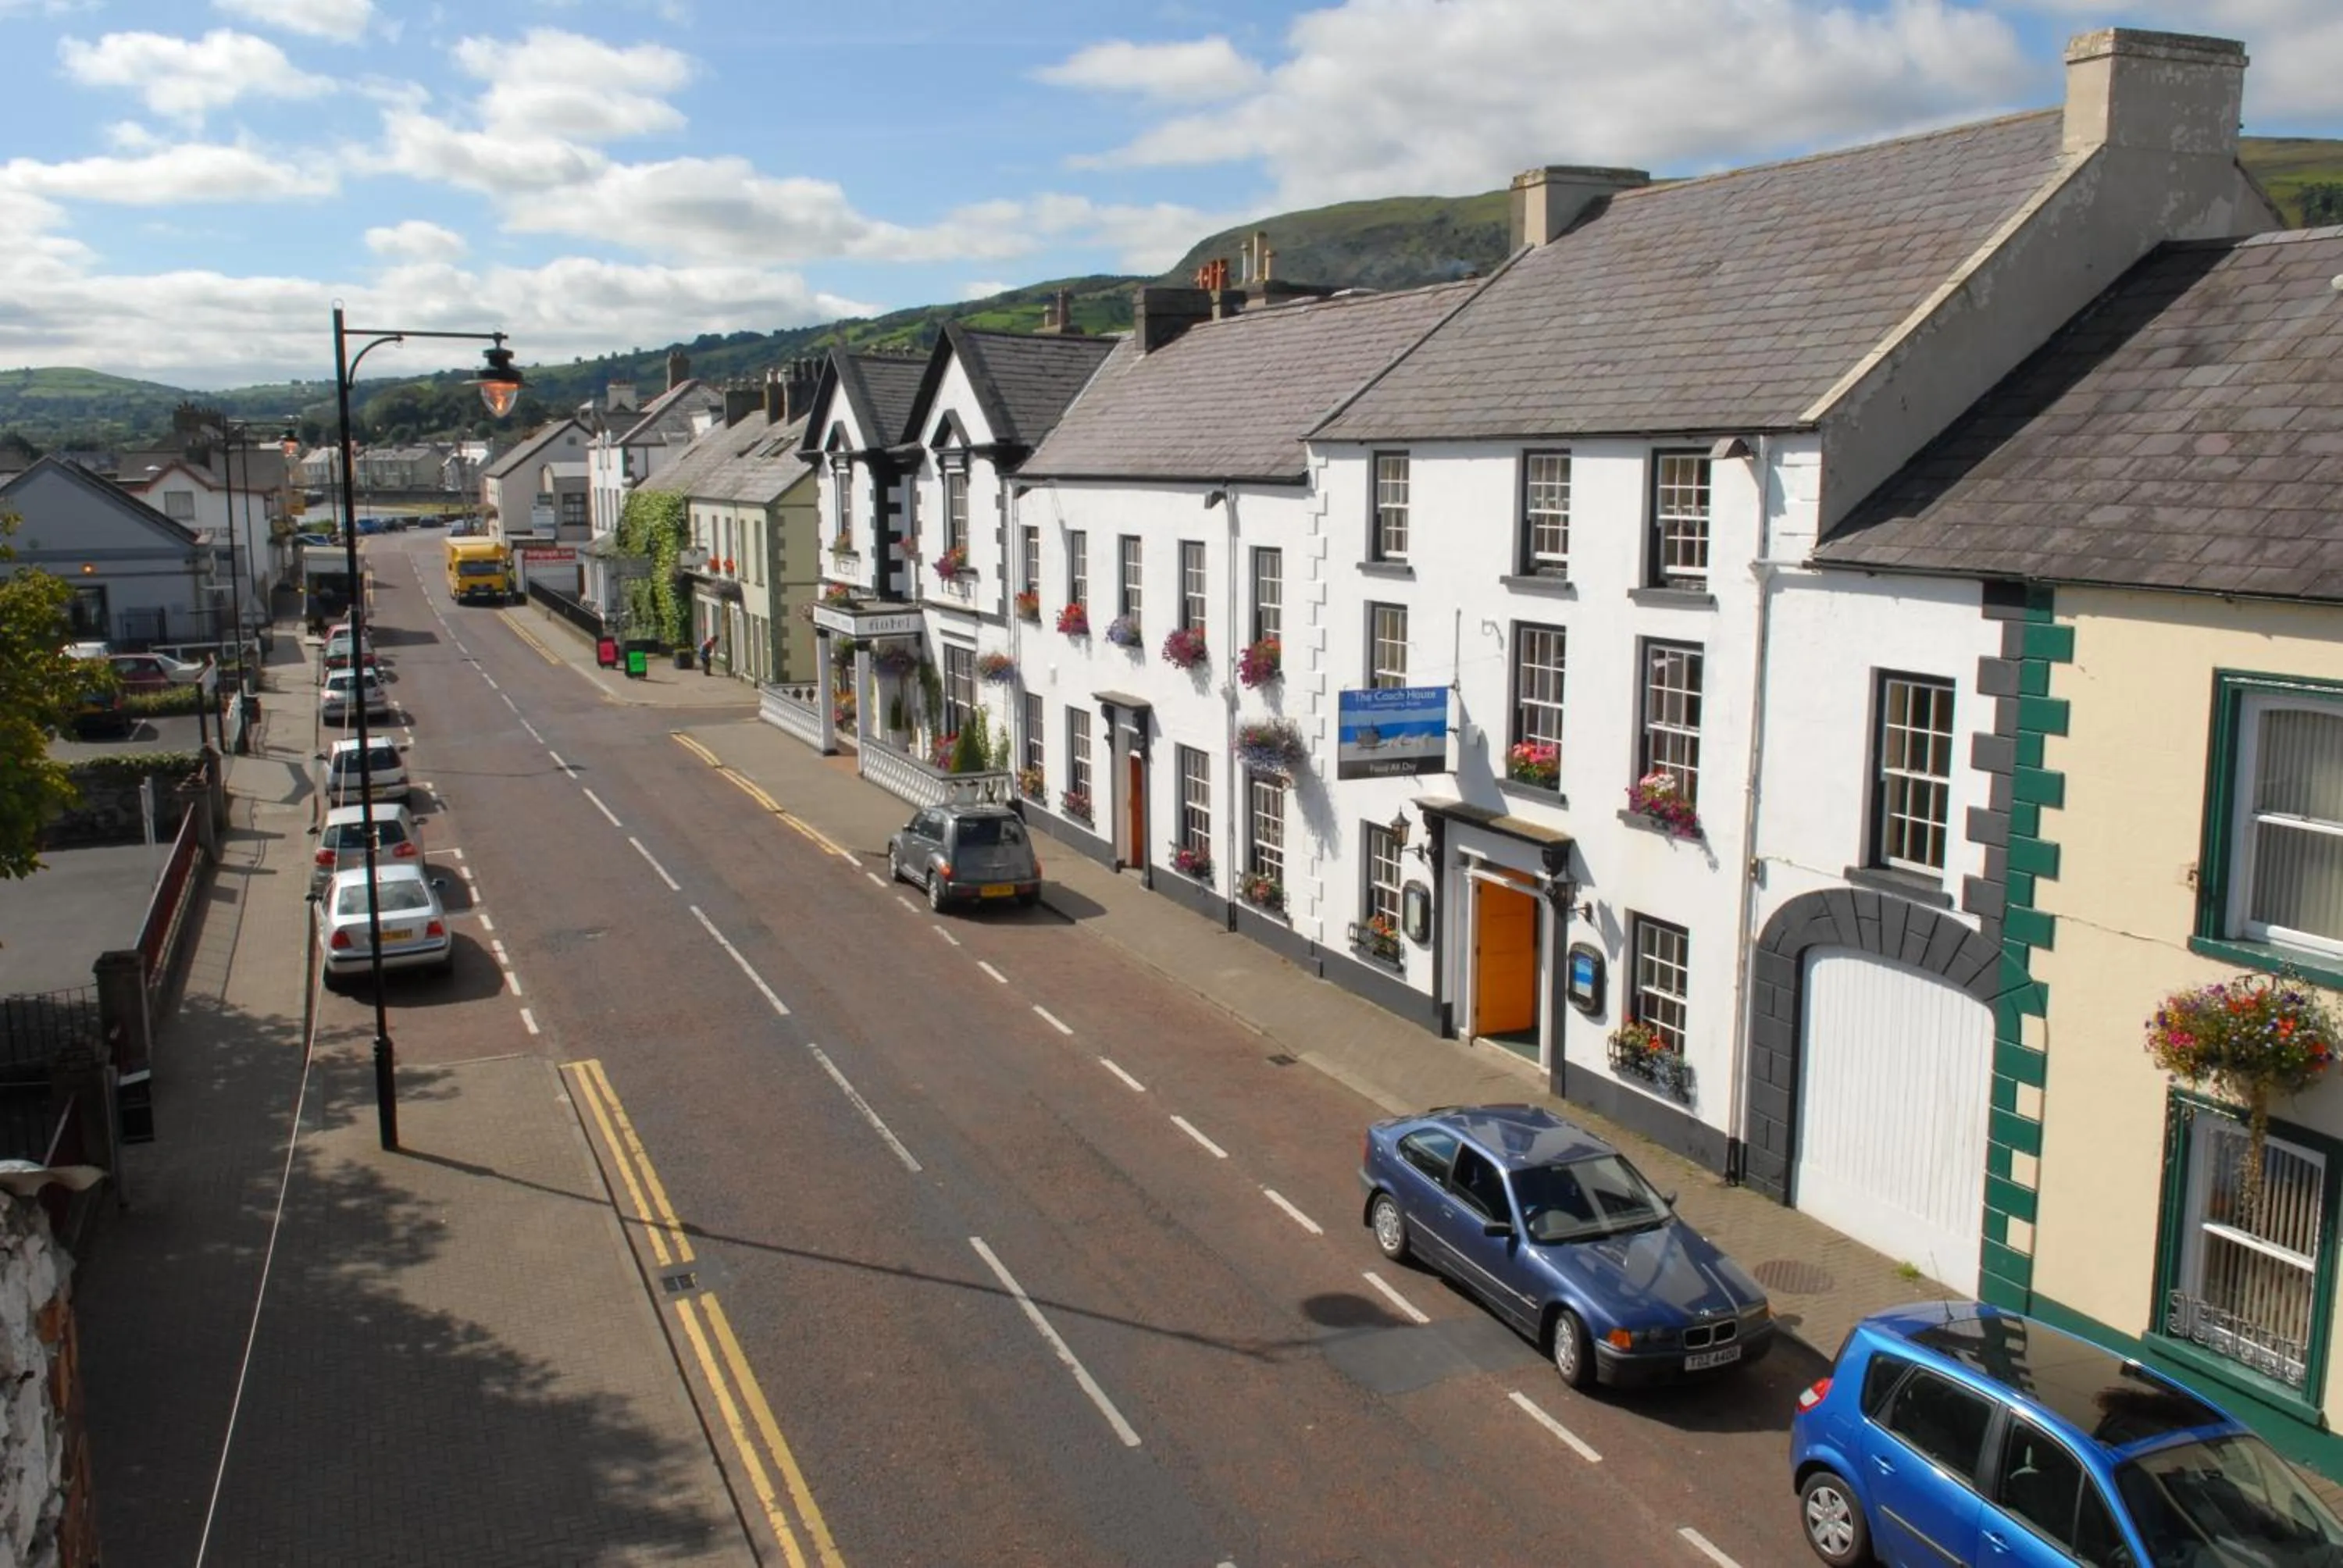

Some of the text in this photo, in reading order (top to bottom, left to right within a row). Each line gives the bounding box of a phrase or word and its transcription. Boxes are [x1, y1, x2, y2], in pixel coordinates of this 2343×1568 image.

[1355, 690, 1435, 702] The Coach House
[1402, 762, 1417, 772] Day
